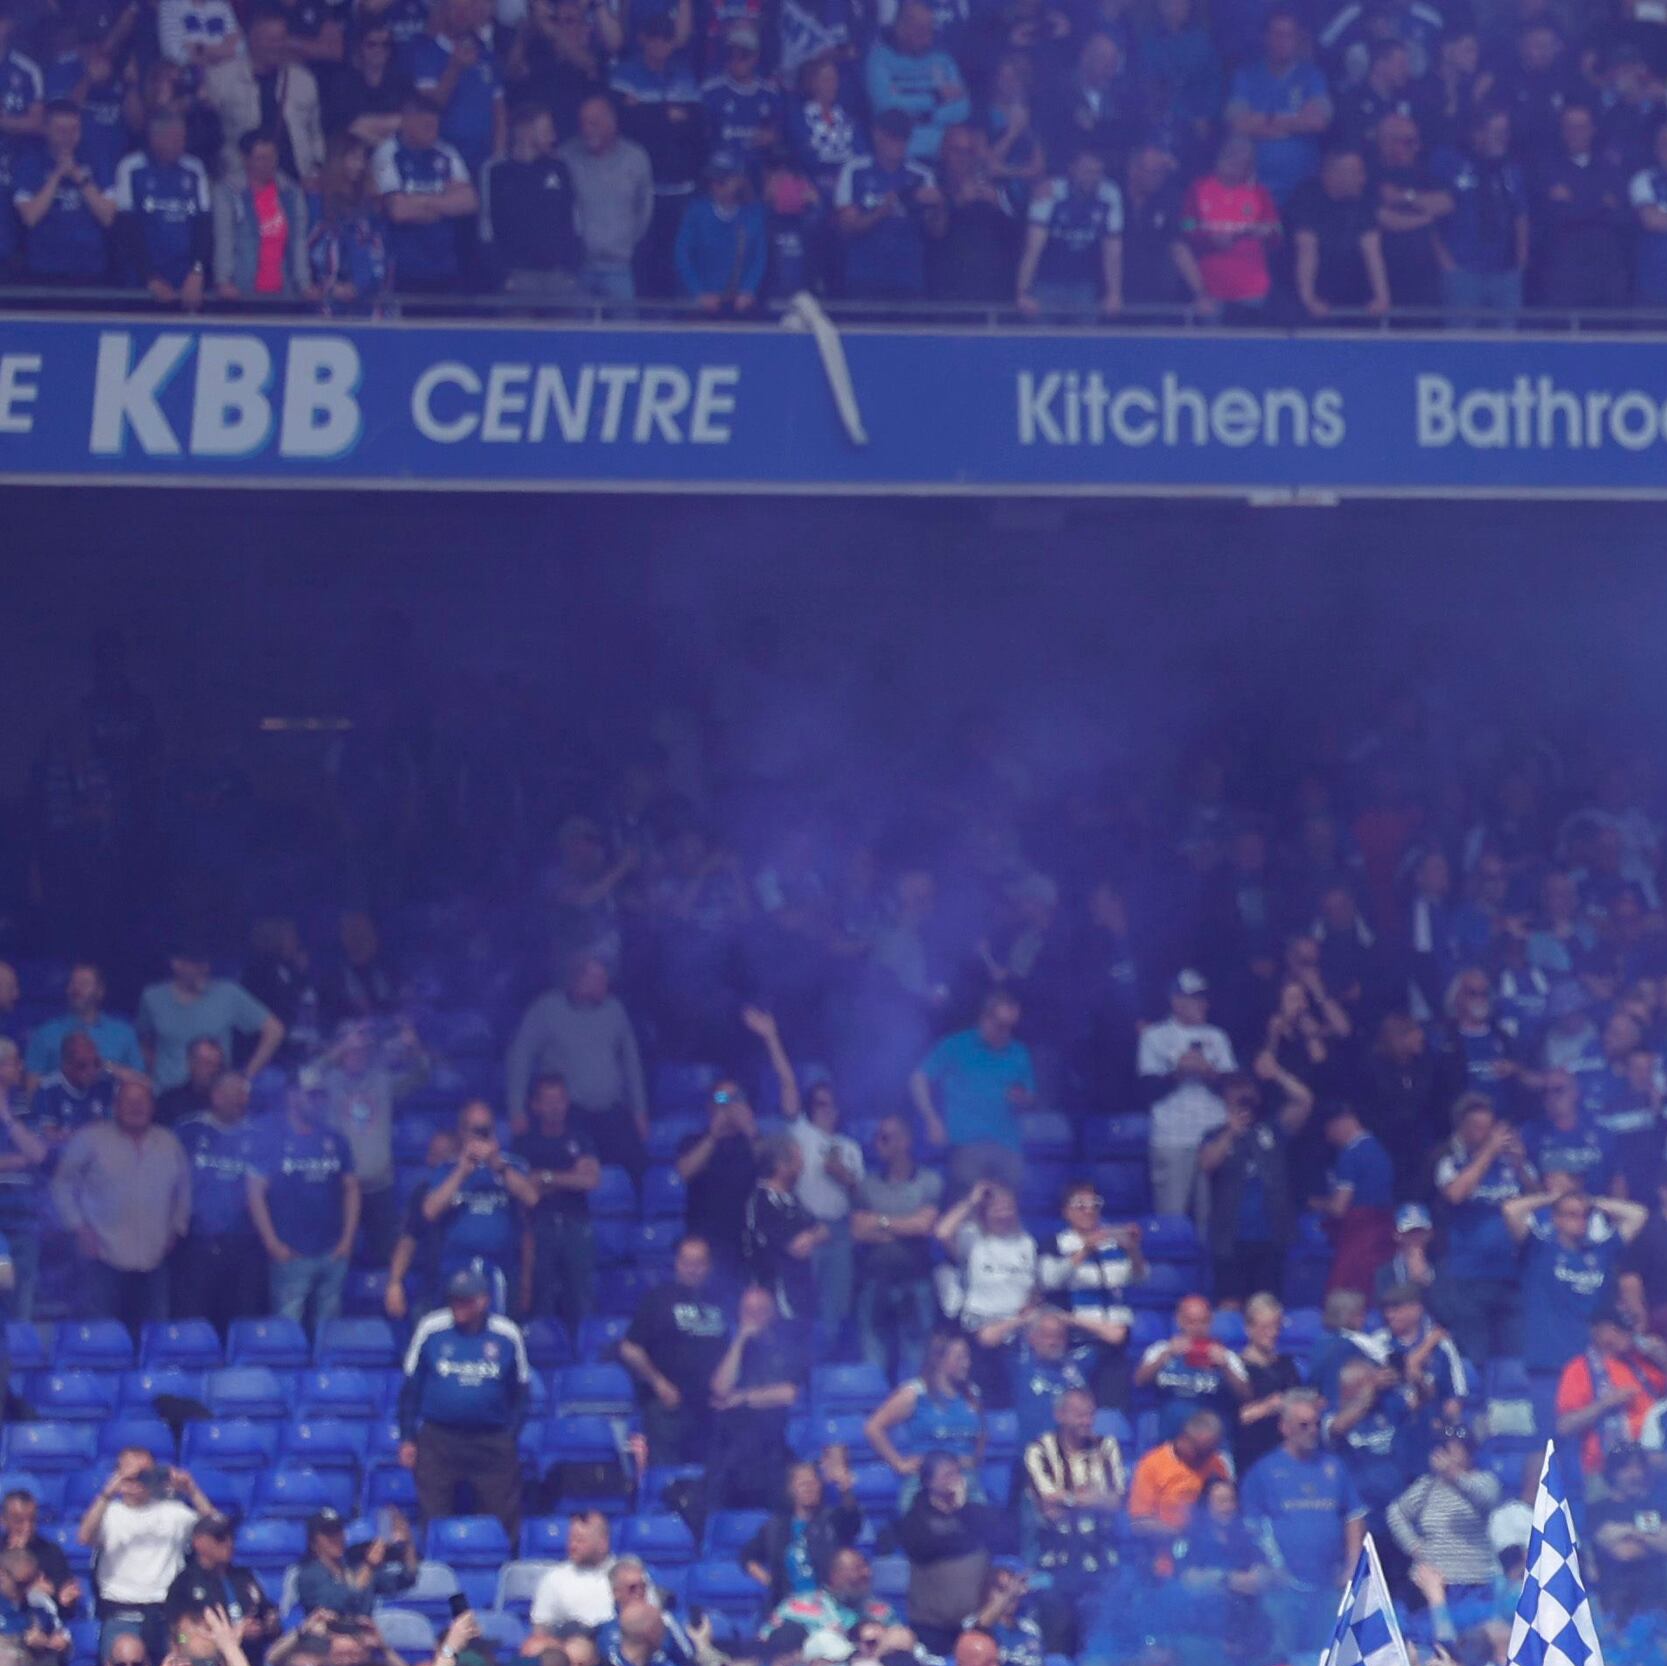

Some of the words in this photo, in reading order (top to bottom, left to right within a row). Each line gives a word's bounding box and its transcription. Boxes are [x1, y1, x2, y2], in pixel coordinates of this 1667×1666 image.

[90, 333, 361, 458] KBB
[412, 363, 739, 443] CENTRE
[1018, 371, 1346, 448] Kitchens
